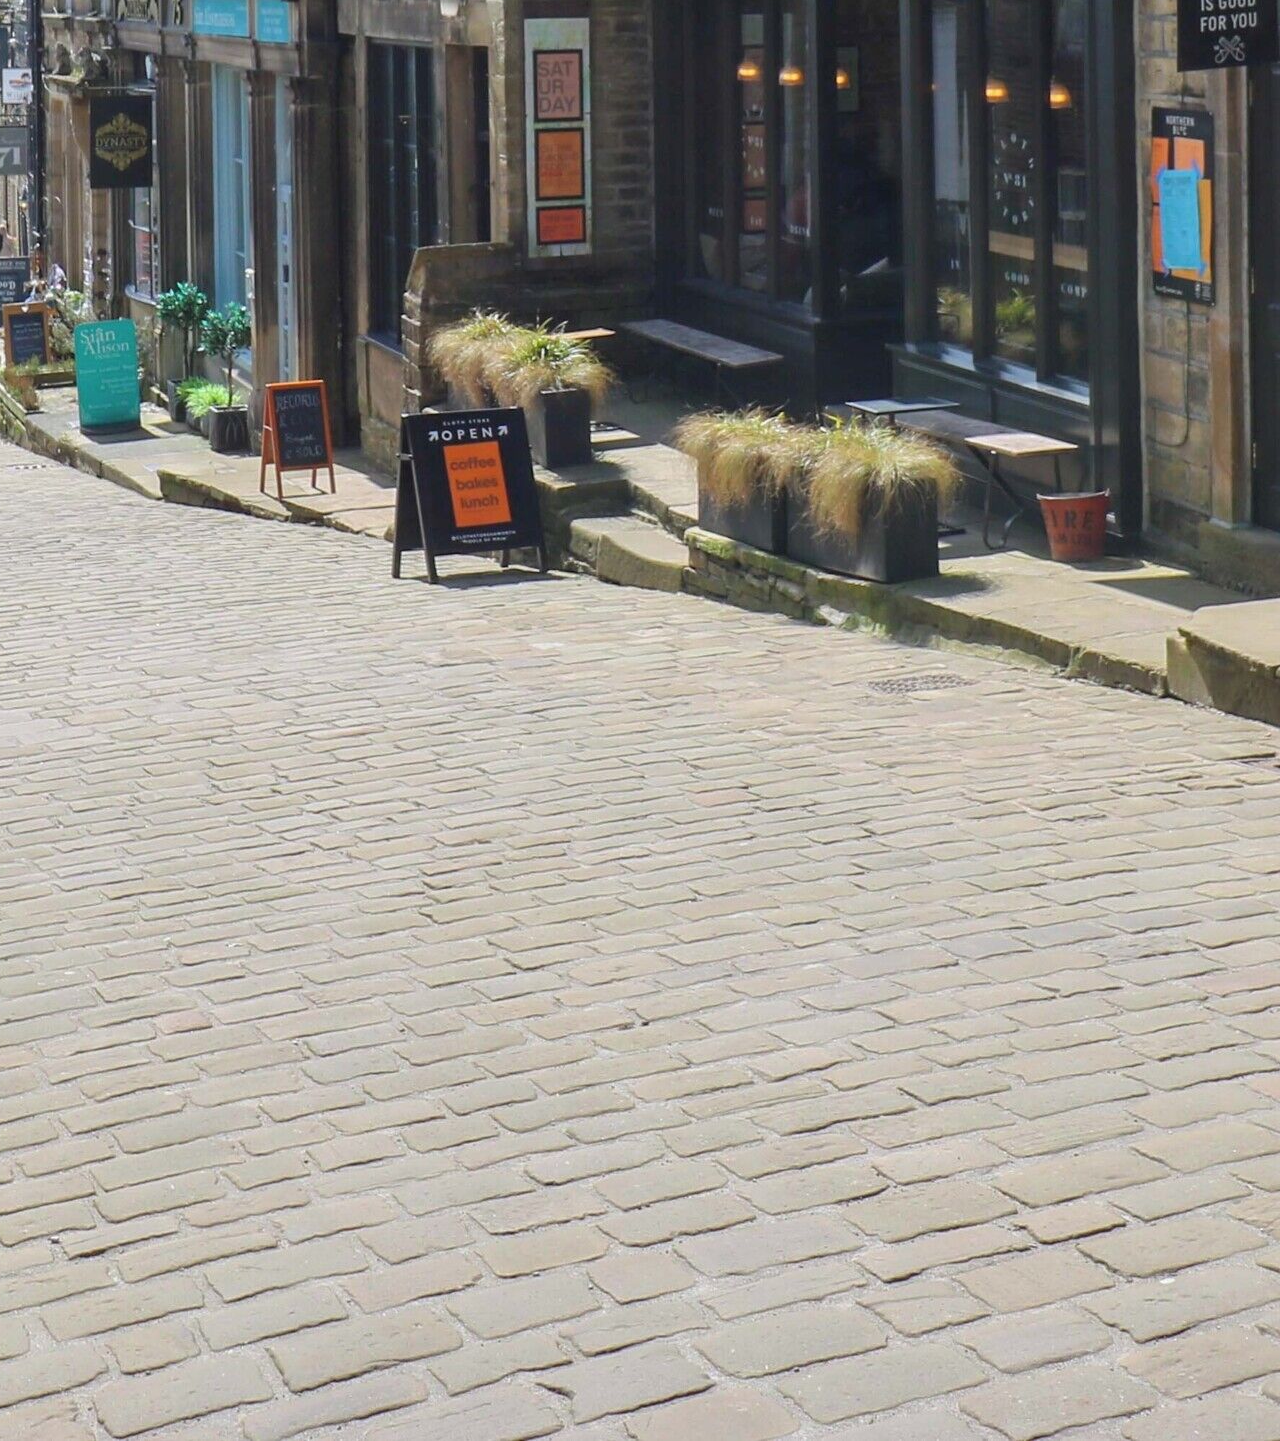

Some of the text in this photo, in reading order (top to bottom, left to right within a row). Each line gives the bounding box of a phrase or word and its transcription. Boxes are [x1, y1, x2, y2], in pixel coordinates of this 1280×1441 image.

[1200, 12, 1257, 33] FOR YOU
[538, 61, 573, 77] SAT
[538, 79, 564, 94] UR
[539, 97, 576, 113] DAY
[95, 136, 147, 147] DYNASTY
[442, 426, 493, 441] OPEN
[450, 457, 496, 471] coffee
[456, 477, 498, 490] bakes
[461, 495, 499, 509] lunch
